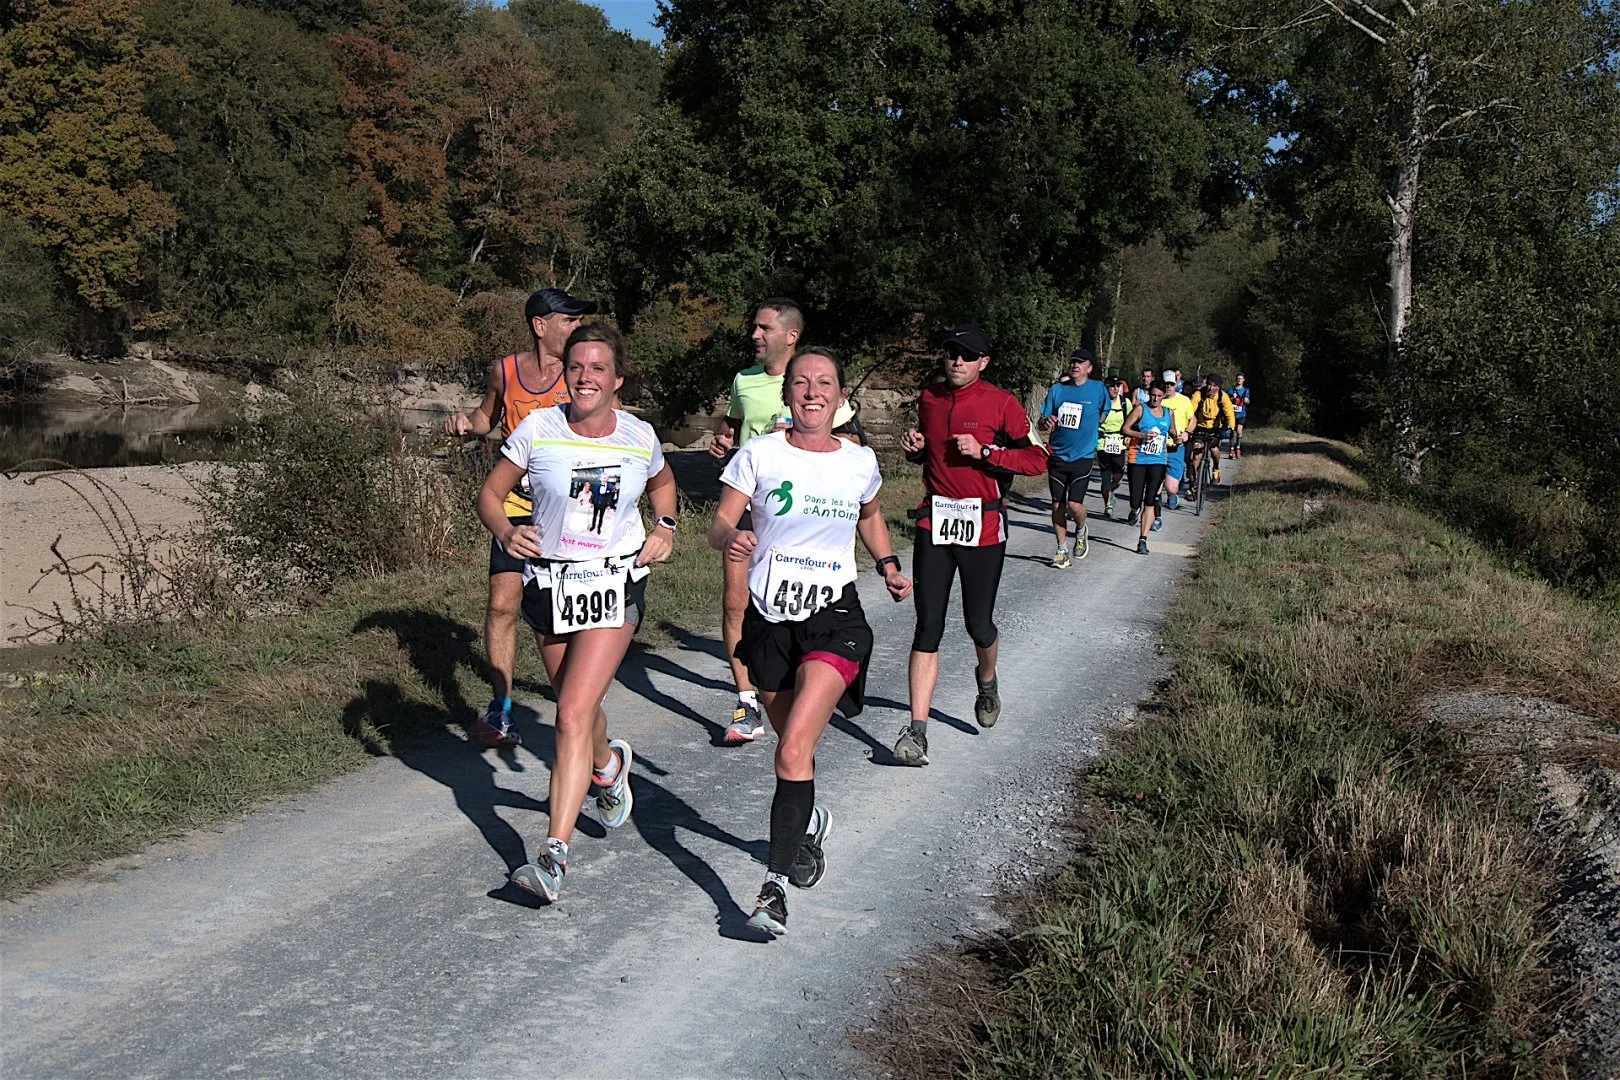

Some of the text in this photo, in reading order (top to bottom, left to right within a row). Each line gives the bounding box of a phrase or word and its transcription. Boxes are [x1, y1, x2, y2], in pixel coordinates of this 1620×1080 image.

[1061, 413, 1077, 426] 4176
[804, 494, 826, 504] Dans
[831, 498, 843, 506] les
[935, 501, 968, 510] Carrefour
[775, 553, 827, 569] Carrefour
[555, 568, 604, 580] Carrefour
[773, 579, 834, 615] 4343
[561, 588, 618, 627] 4399
